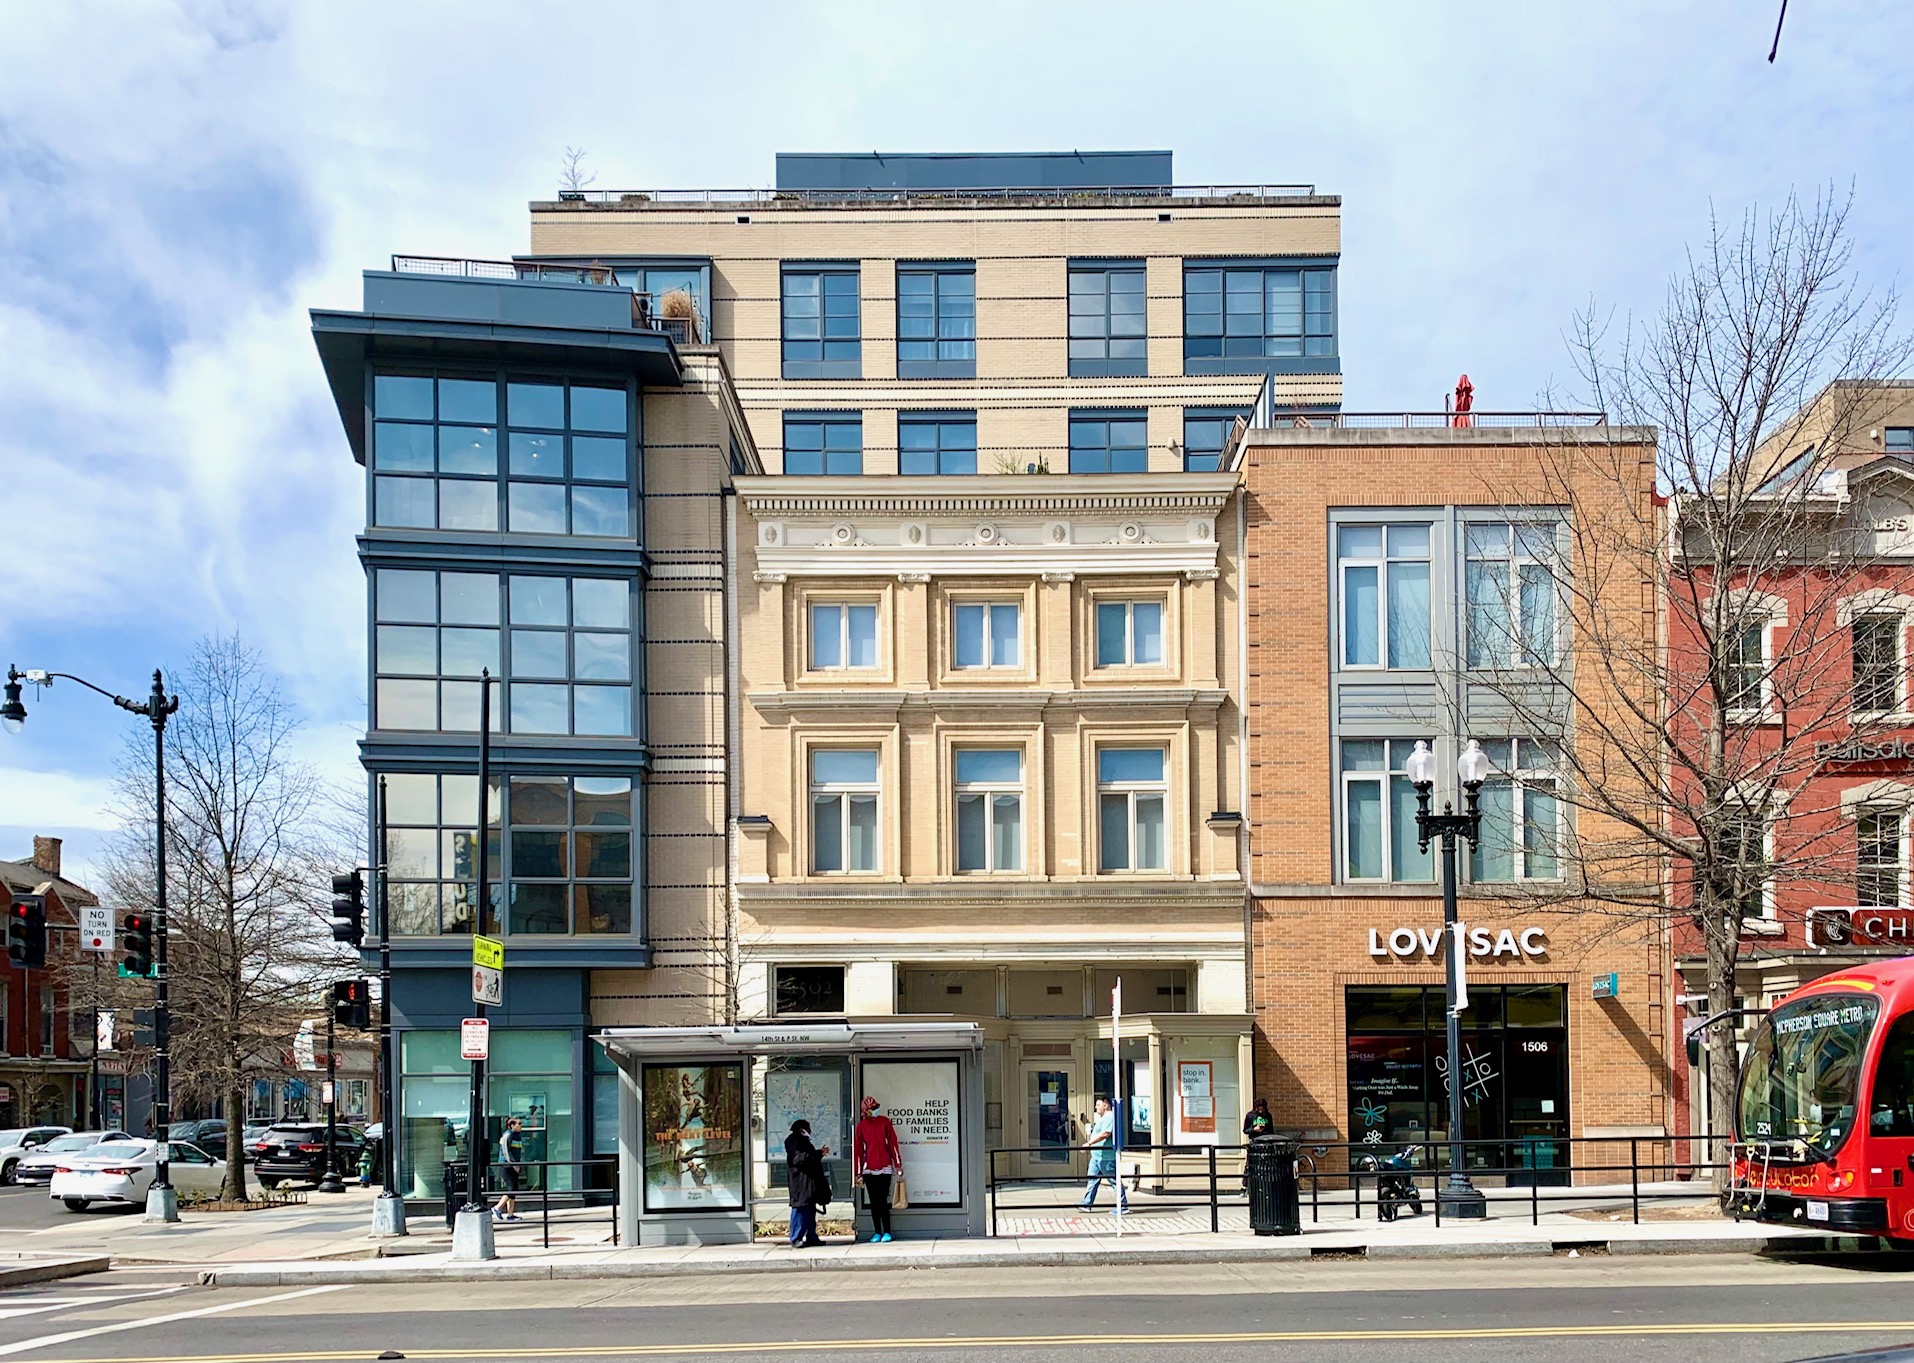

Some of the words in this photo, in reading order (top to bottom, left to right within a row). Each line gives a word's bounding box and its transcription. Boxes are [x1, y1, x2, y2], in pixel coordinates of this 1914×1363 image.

[90, 911, 104, 919] NO
[96, 929, 111, 937] RED
[1368, 927, 1546, 956] LOVSAC
[1776, 1015, 1812, 1035] MCPHERSON
[1813, 1010, 1839, 1029] SQUARE
[1840, 1005, 1863, 1024] METRO
[1521, 1041, 1549, 1052] 1506
[1095, 1064, 1113, 1073] ANK
[1183, 1069, 1197, 1077] stop
[1371, 1078, 1391, 1086] Imagine
[917, 1108, 949, 1116] BANKS
[906, 1117, 949, 1125] FAMILIES
[911, 1126, 920, 1134] IN
[923, 1126, 951, 1134] NEED.
[1757, 1122, 1771, 1135] 2524
[655, 1132, 673, 1140] THE
[705, 1130, 732, 1139] LEVEL
